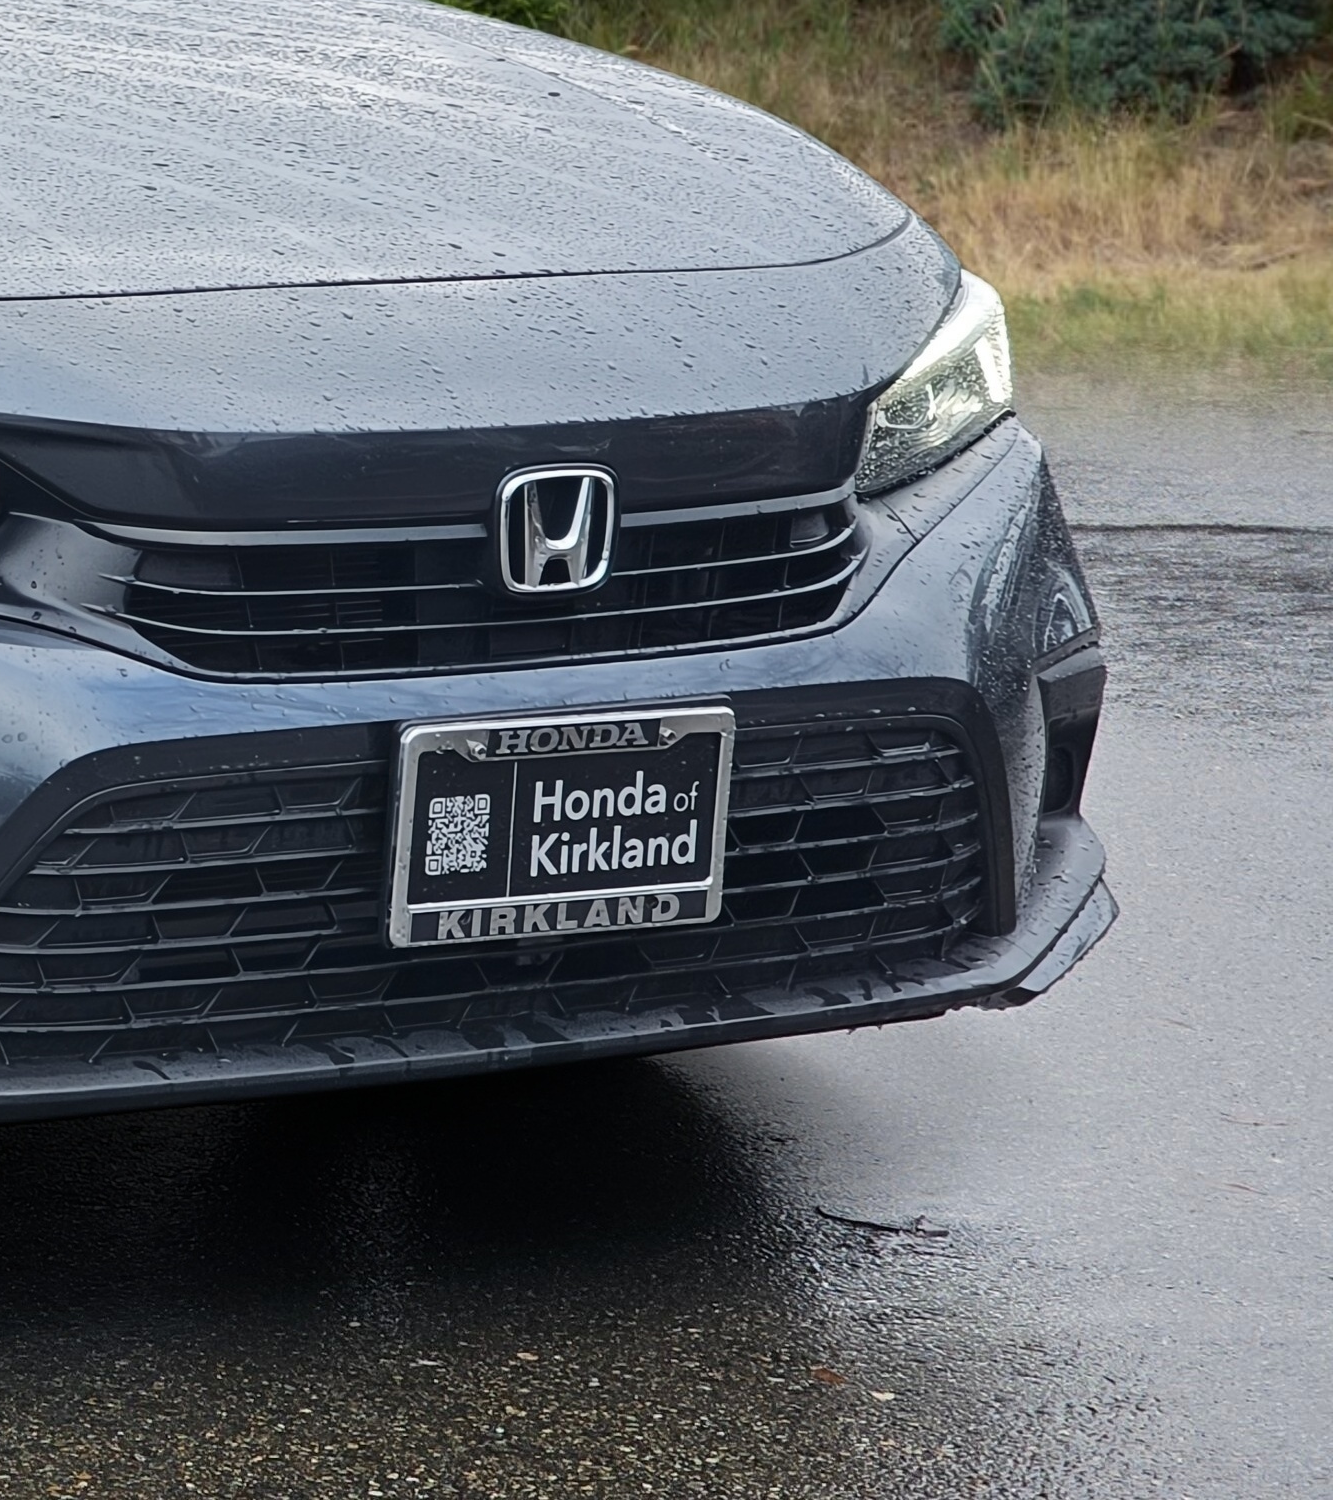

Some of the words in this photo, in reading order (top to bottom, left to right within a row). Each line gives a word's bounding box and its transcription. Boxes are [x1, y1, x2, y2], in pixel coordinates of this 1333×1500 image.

[495, 722, 649, 755] HONDA
[533, 770, 668, 823] Honda
[673, 780, 700, 813] of
[529, 818, 698, 877] Kirkland
[436, 893, 681, 941] KIRKLAND
